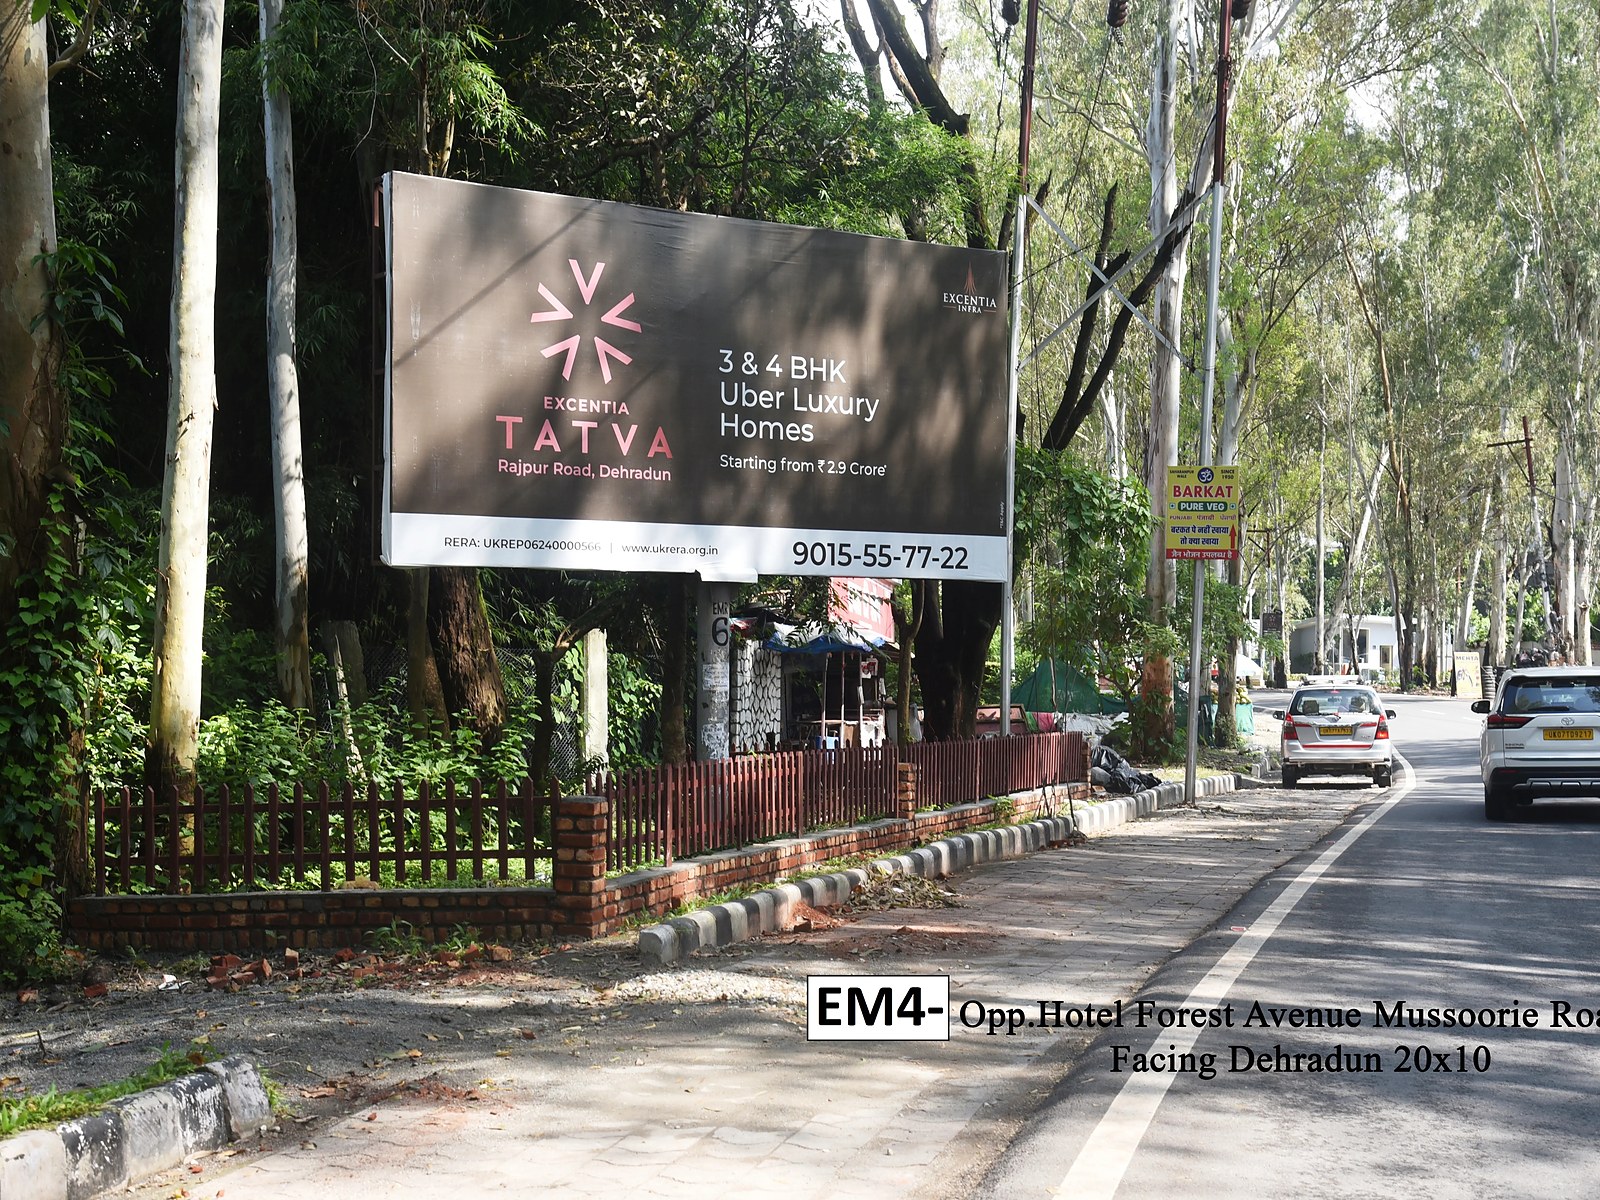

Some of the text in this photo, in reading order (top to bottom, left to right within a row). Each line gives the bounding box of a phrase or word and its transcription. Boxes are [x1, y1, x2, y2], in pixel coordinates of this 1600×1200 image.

[943, 292, 997, 308] EXCENTIA
[958, 304, 982, 314] INFRA
[718, 349, 847, 383] 3 & 4 BHK
[543, 396, 630, 415] EXCENTIA
[720, 381, 880, 422] Uber Luxury
[720, 412, 814, 442] Homes
[495, 415, 673, 459] TATVA
[498, 459, 671, 481] Rajpur Road, Dehradun
[720, 454, 777, 473] Starting
[781, 457, 814, 473] from
[1173, 485, 1233, 498] BARKAT
[1180, 502, 1225, 511] PURE VEG
[1170, 526, 1190, 534] बरकत
[444, 537, 480, 548] RERA:
[622, 543, 719, 556] www.ukrera.org.in
[1180, 535, 1188, 545] तो
[792, 541, 969, 570] 9015-55-77-22
[711, 616, 729, 647] 6
